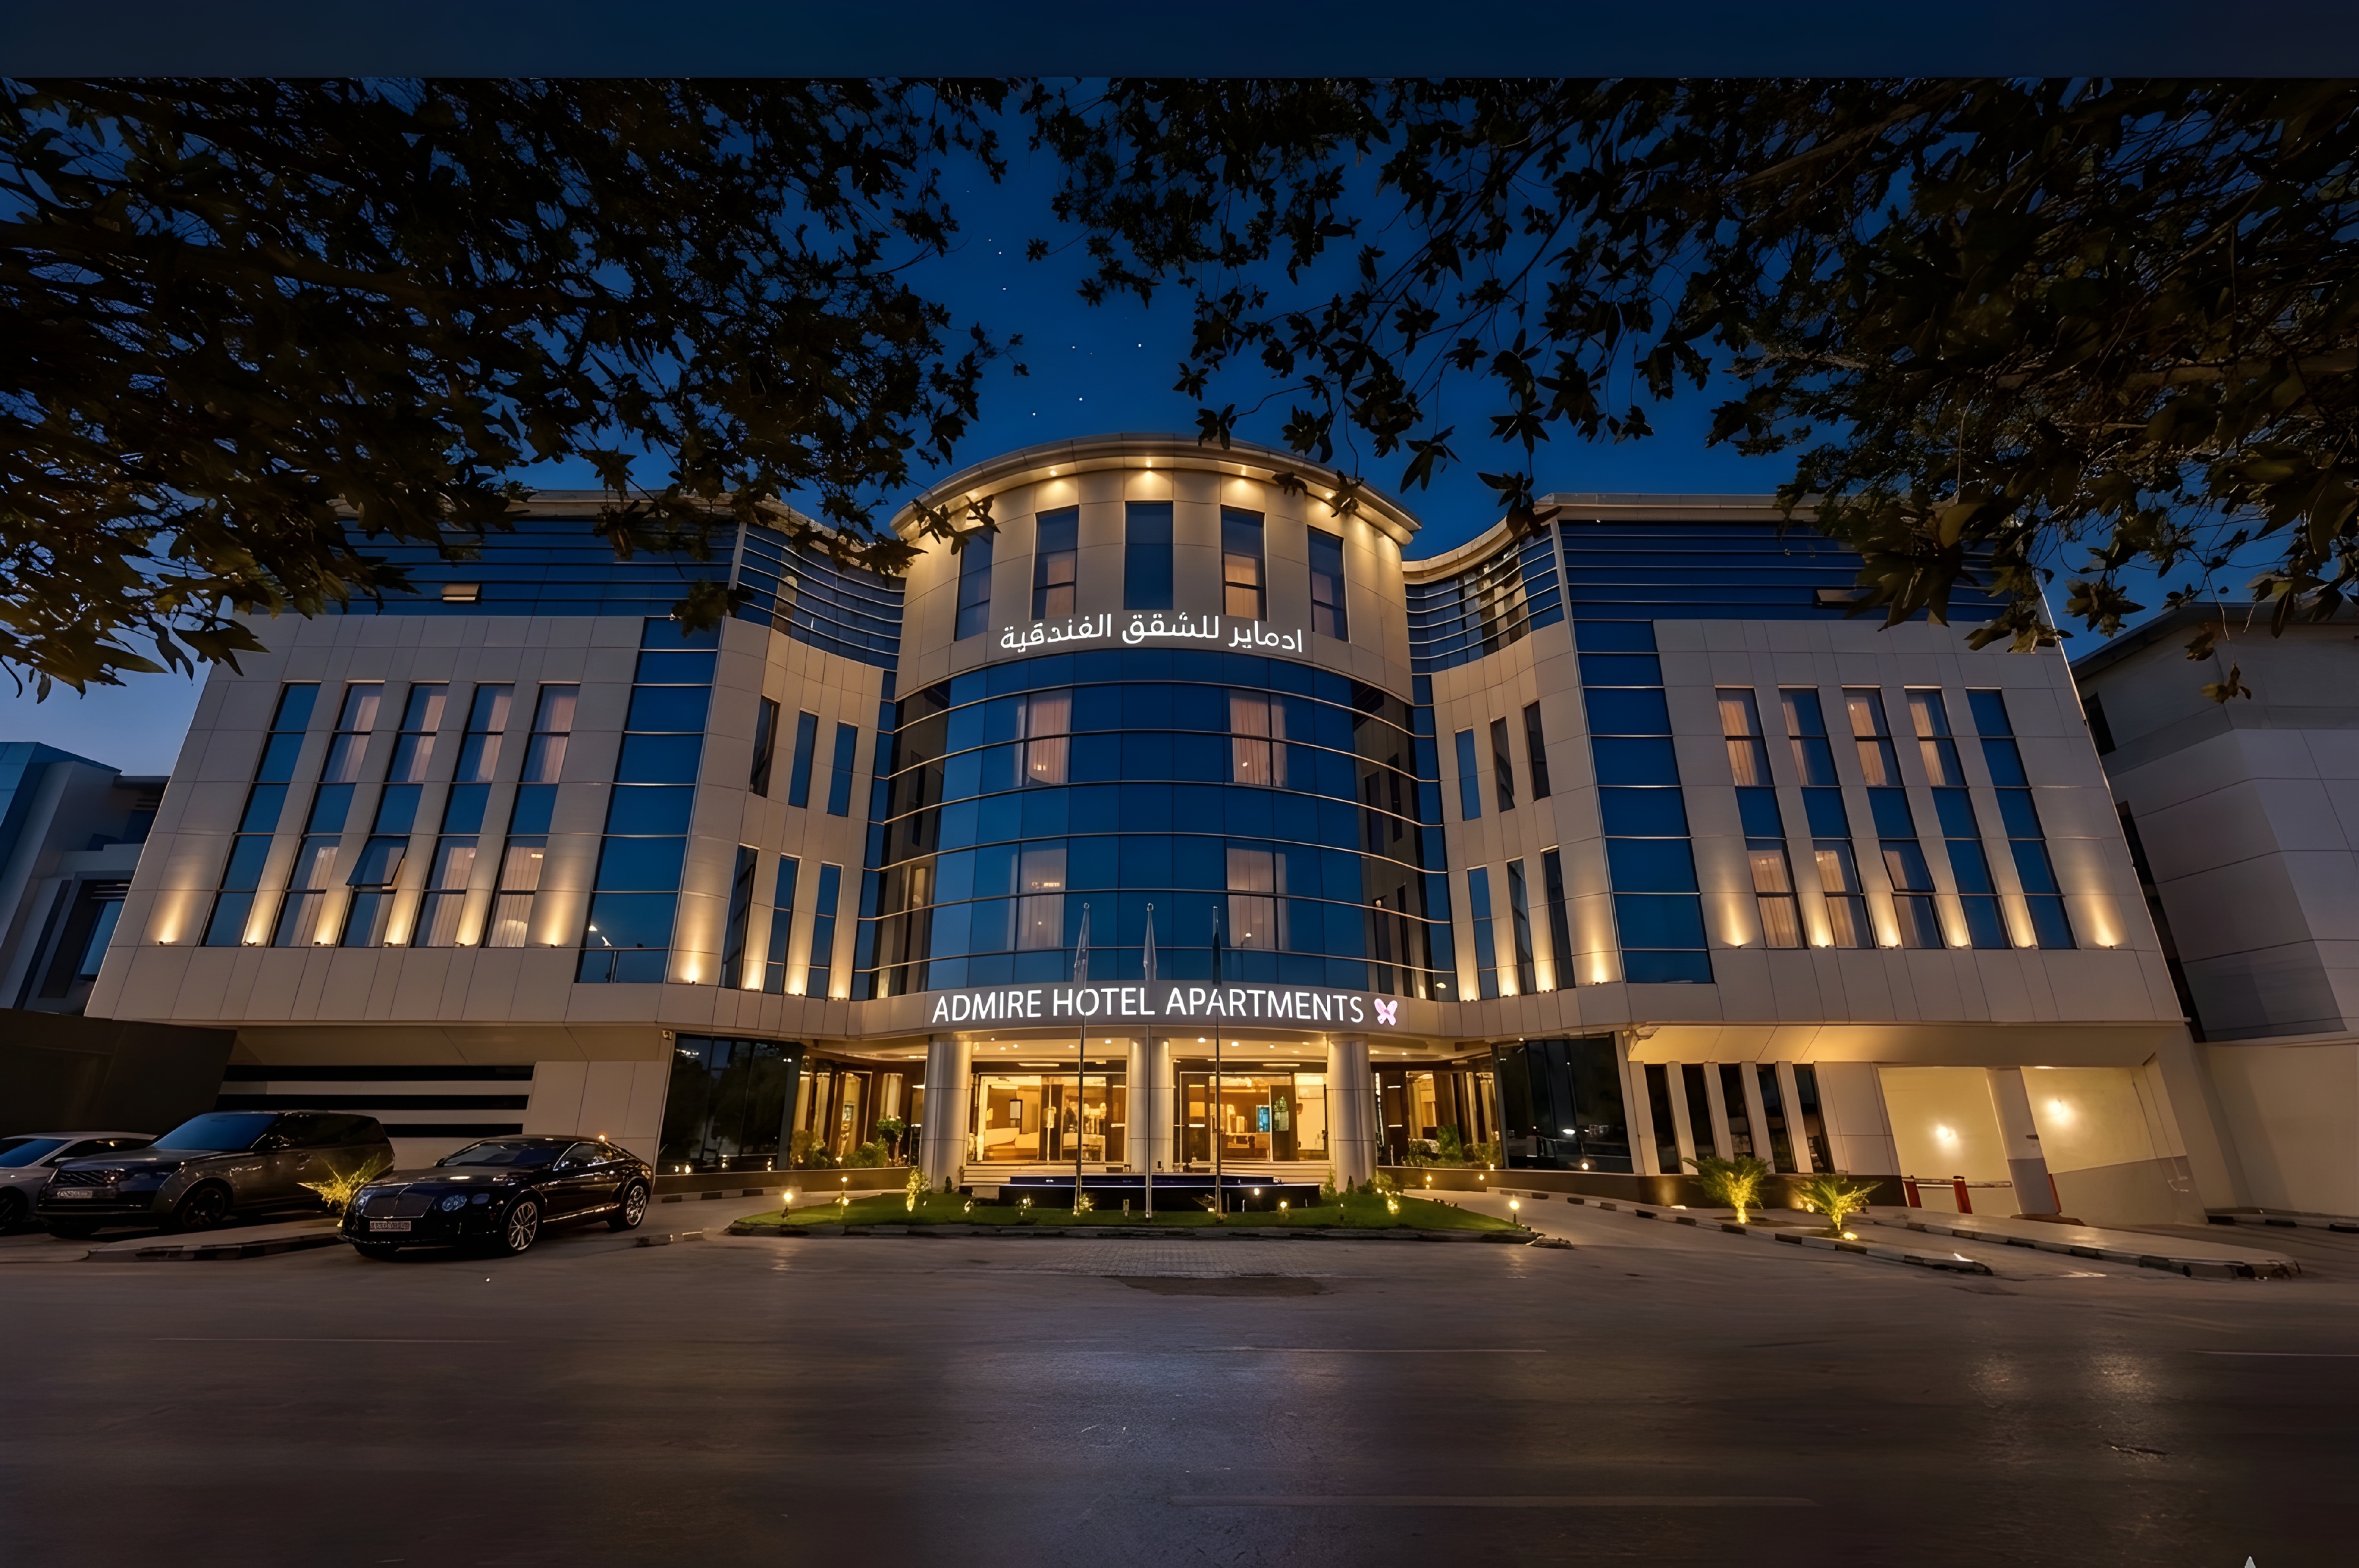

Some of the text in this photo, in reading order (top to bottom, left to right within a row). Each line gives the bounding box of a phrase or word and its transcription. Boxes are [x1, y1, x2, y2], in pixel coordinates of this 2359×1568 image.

[1000, 611, 1303, 654] ادماير للشقق الفندقية
[931, 986, 1364, 1024] ADMIRE HOTEL APARTMENTS
